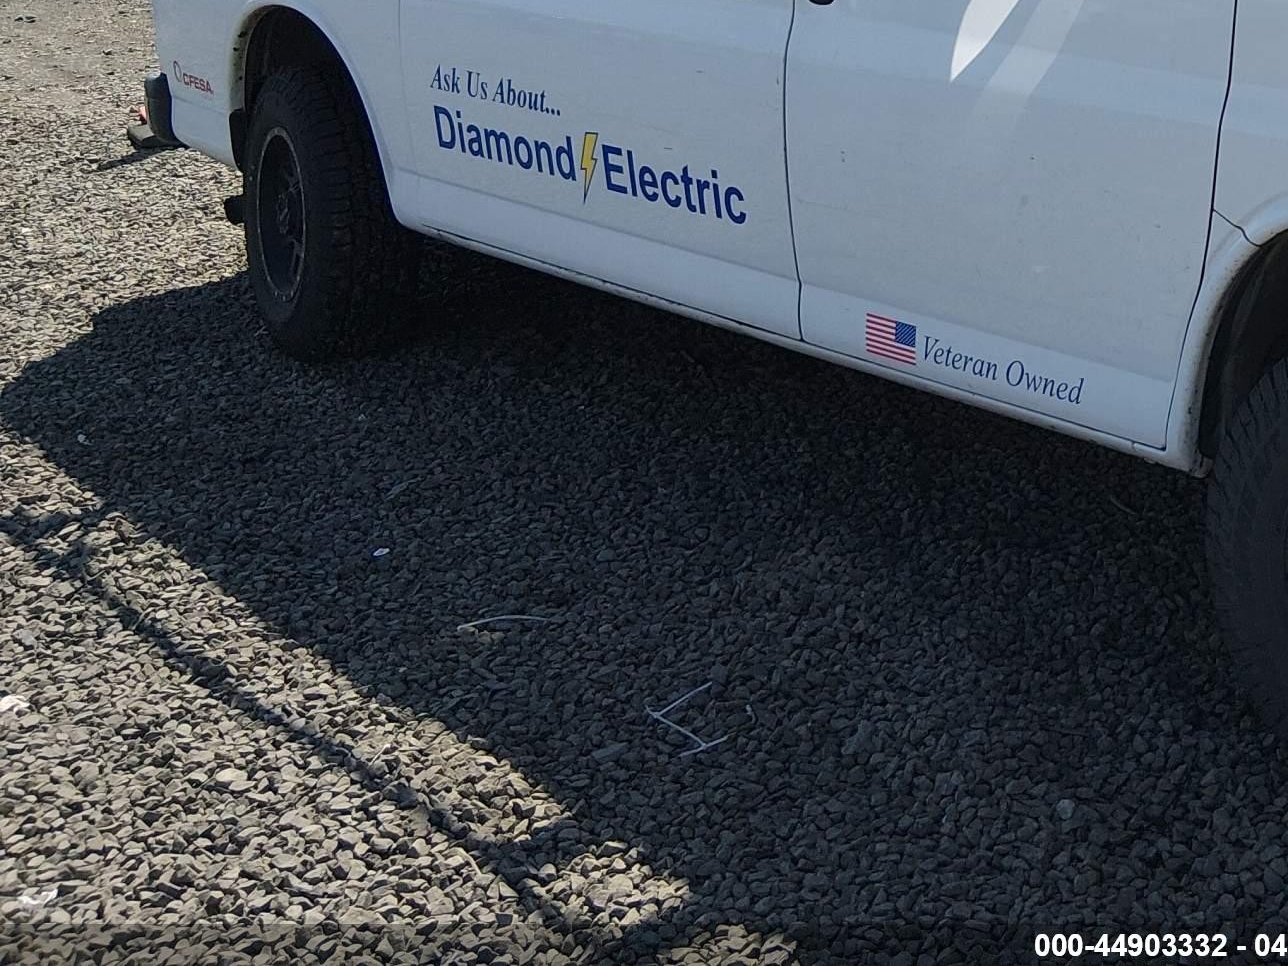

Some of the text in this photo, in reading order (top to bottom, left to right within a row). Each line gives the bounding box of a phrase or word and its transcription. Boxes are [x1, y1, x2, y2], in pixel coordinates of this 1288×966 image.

[430, 64, 561, 116] Ask Us About...
[433, 105, 747, 224] Diamond Electric
[923, 335, 1085, 405] Veteran Owned
